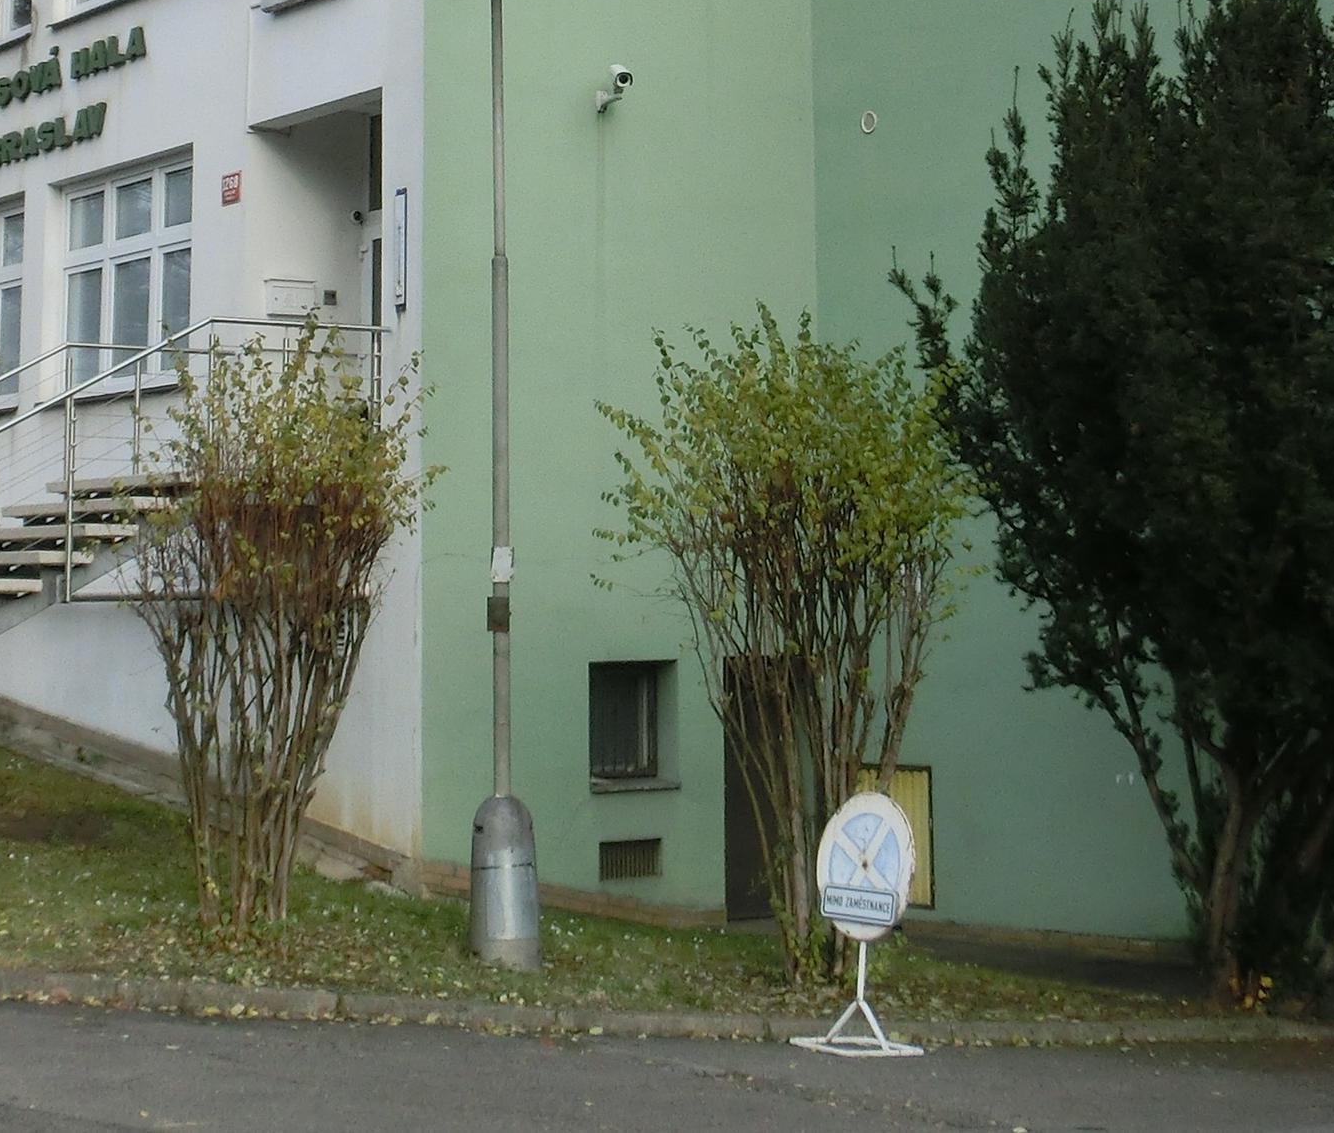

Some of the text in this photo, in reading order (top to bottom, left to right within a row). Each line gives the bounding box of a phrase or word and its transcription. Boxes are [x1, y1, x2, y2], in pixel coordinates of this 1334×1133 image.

[71, 26, 147, 80] HALA
[826, 894, 891, 914] MIMO ZAMĚSTNANCE
